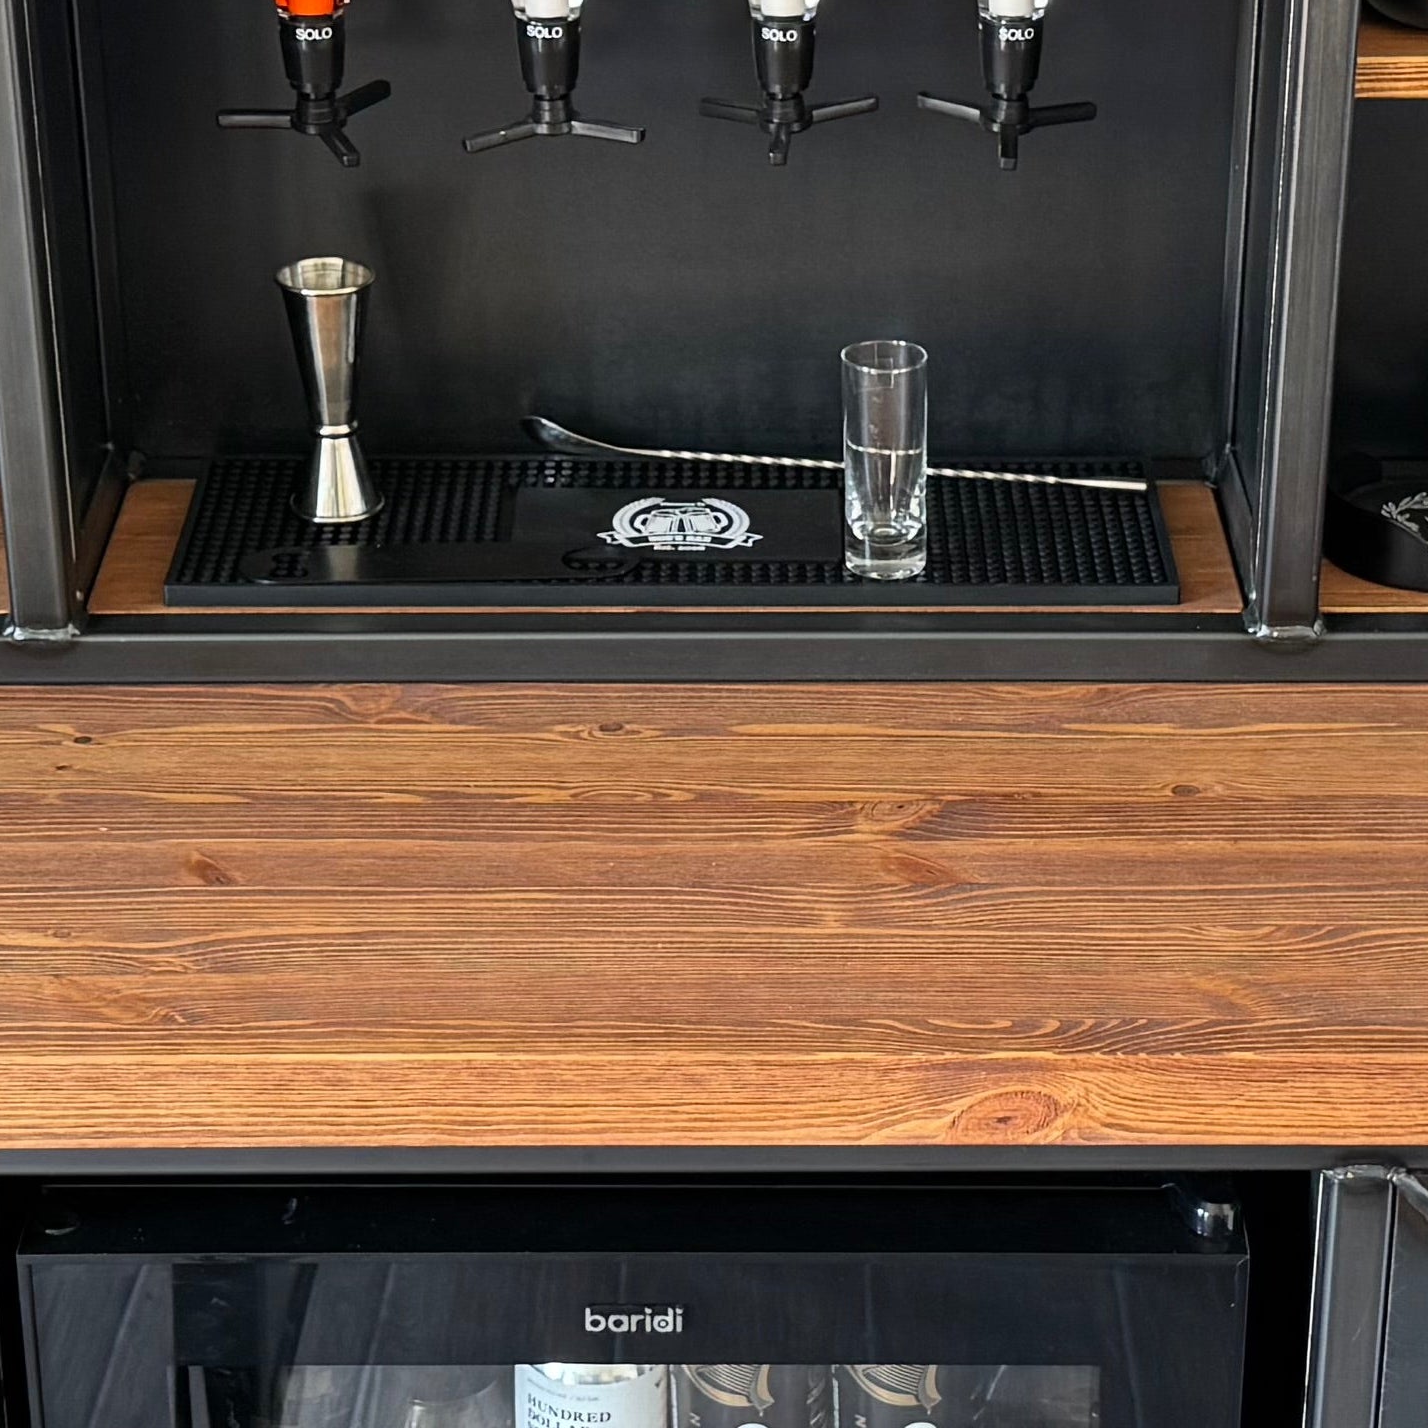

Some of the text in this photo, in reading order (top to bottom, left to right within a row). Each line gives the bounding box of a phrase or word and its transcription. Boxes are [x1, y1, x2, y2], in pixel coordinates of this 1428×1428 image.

[295, 27, 333, 41] SOLO
[526, 25, 563, 39] SOLO
[761, 27, 798, 42] SOLO
[998, 26, 1035, 42] SOLO
[584, 1306, 686, 1334] baridi
[527, 1392, 612, 1424] HUNDRED
